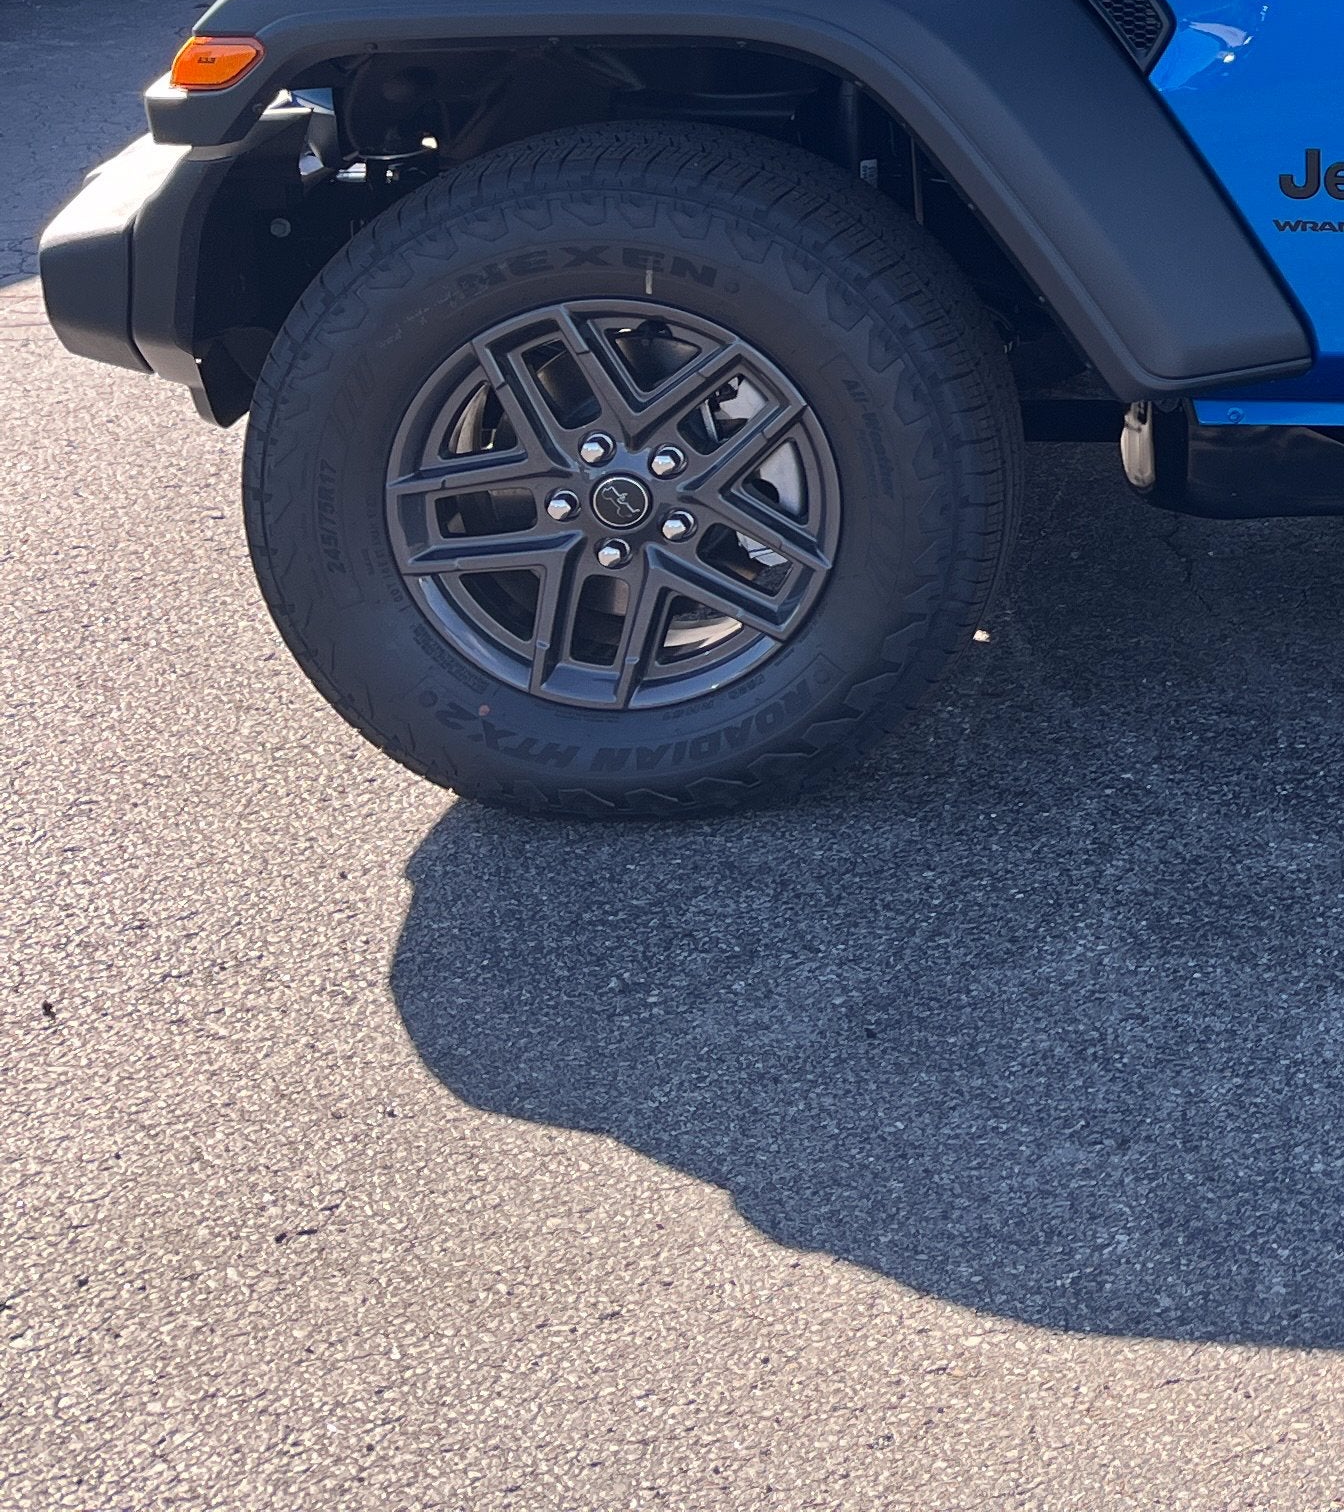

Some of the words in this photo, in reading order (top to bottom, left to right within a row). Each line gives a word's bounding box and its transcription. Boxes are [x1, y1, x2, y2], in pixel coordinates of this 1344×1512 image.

[455, 245, 718, 295] NEXEN
[317, 457, 347, 574] 245/75R17
[590, 686, 803, 771] ROADIAN
